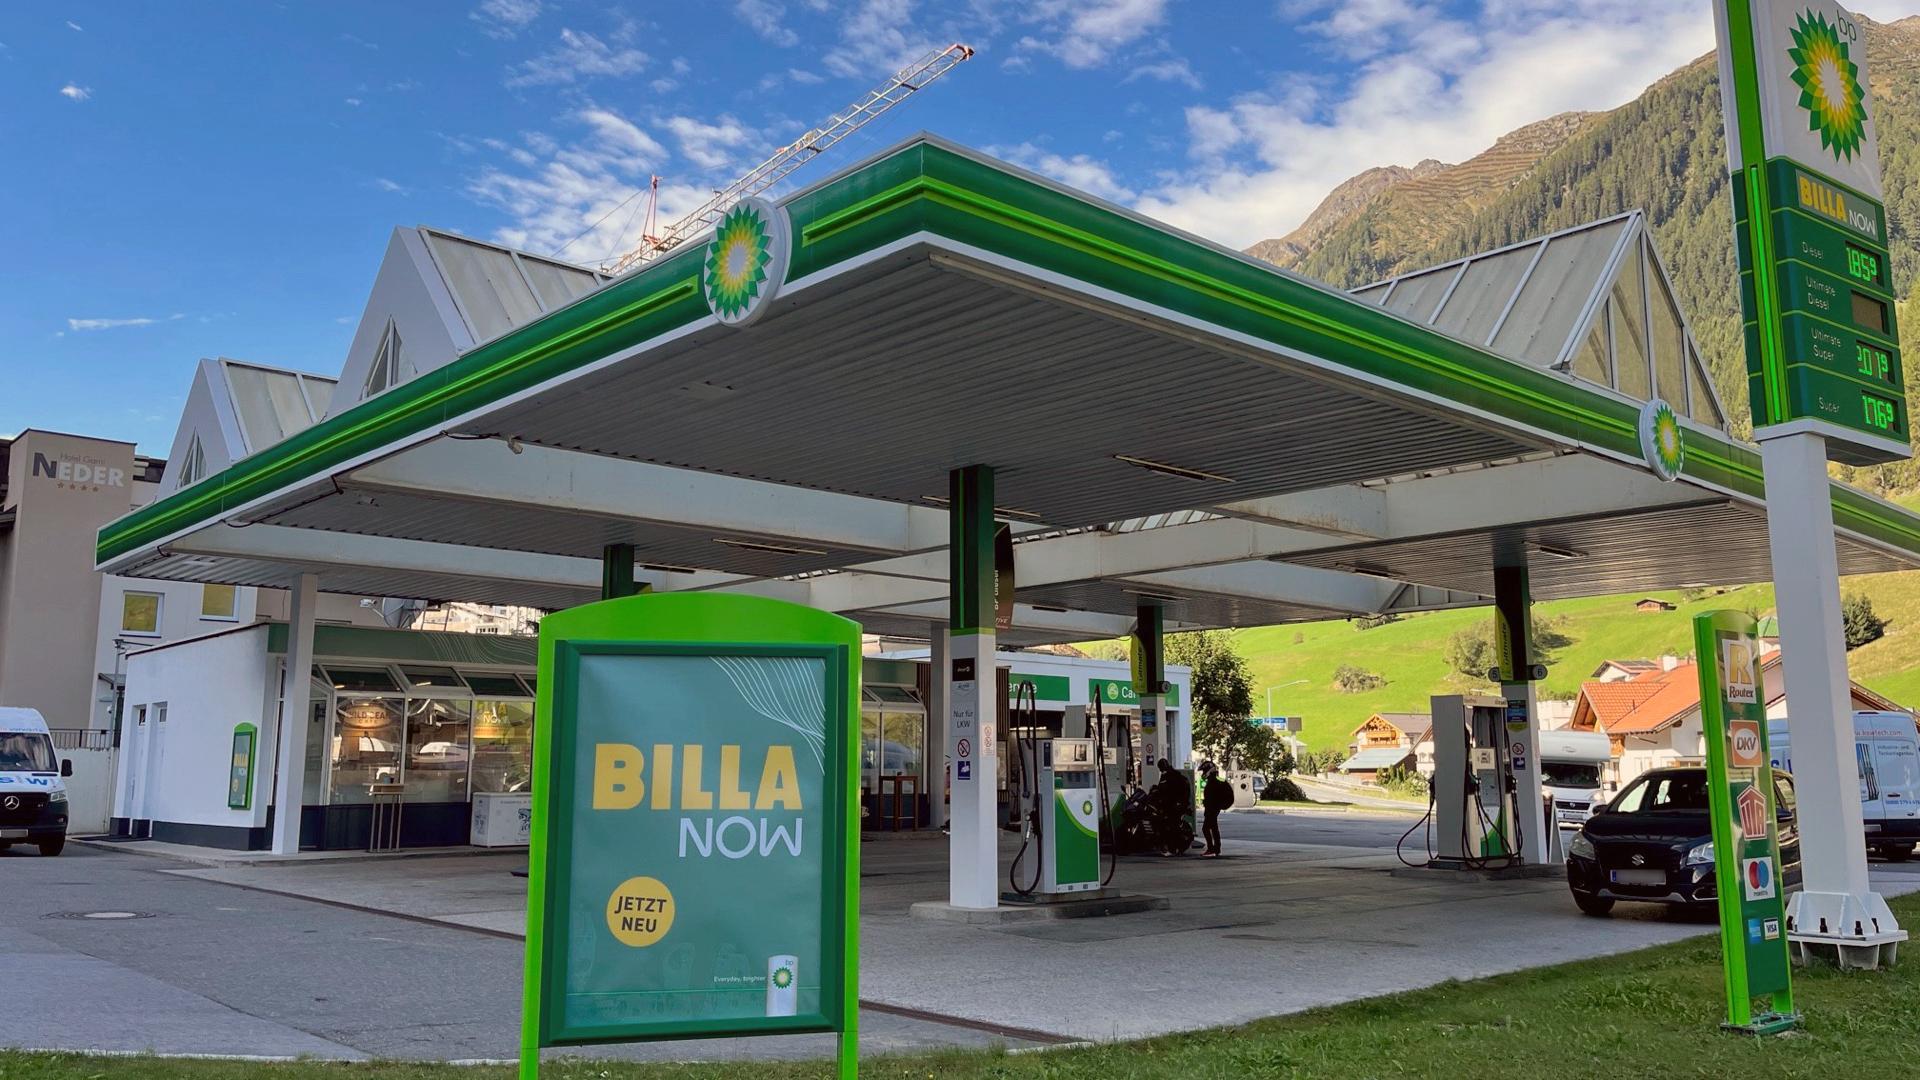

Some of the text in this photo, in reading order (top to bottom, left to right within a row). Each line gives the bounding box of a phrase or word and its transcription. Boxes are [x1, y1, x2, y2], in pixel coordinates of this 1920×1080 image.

[1837, 10, 1857, 45] bp
[1799, 176, 1876, 236] BILLA NOW
[1802, 241, 1824, 260] Diesel
[1806, 276, 1836, 297] Ultimate
[1808, 292, 1830, 311] Diesel
[1811, 327, 1841, 347] Ultimate
[1813, 344, 1834, 361] Super
[1819, 396, 1840, 413] Super
[60, 451, 80, 461] Hotel
[33, 452, 123, 487] NEDER
[1729, 687, 1754, 698] Routex
[953, 710, 964, 718] Nur
[956, 720, 971, 728] LKW
[1736, 736, 1757, 751] DKV
[592, 743, 803, 810] BILLA
[679, 815, 803, 859] NOW
[614, 895, 667, 915] JETZT
[620, 916, 658, 934] NEU
[1766, 923, 1778, 933] VISA
